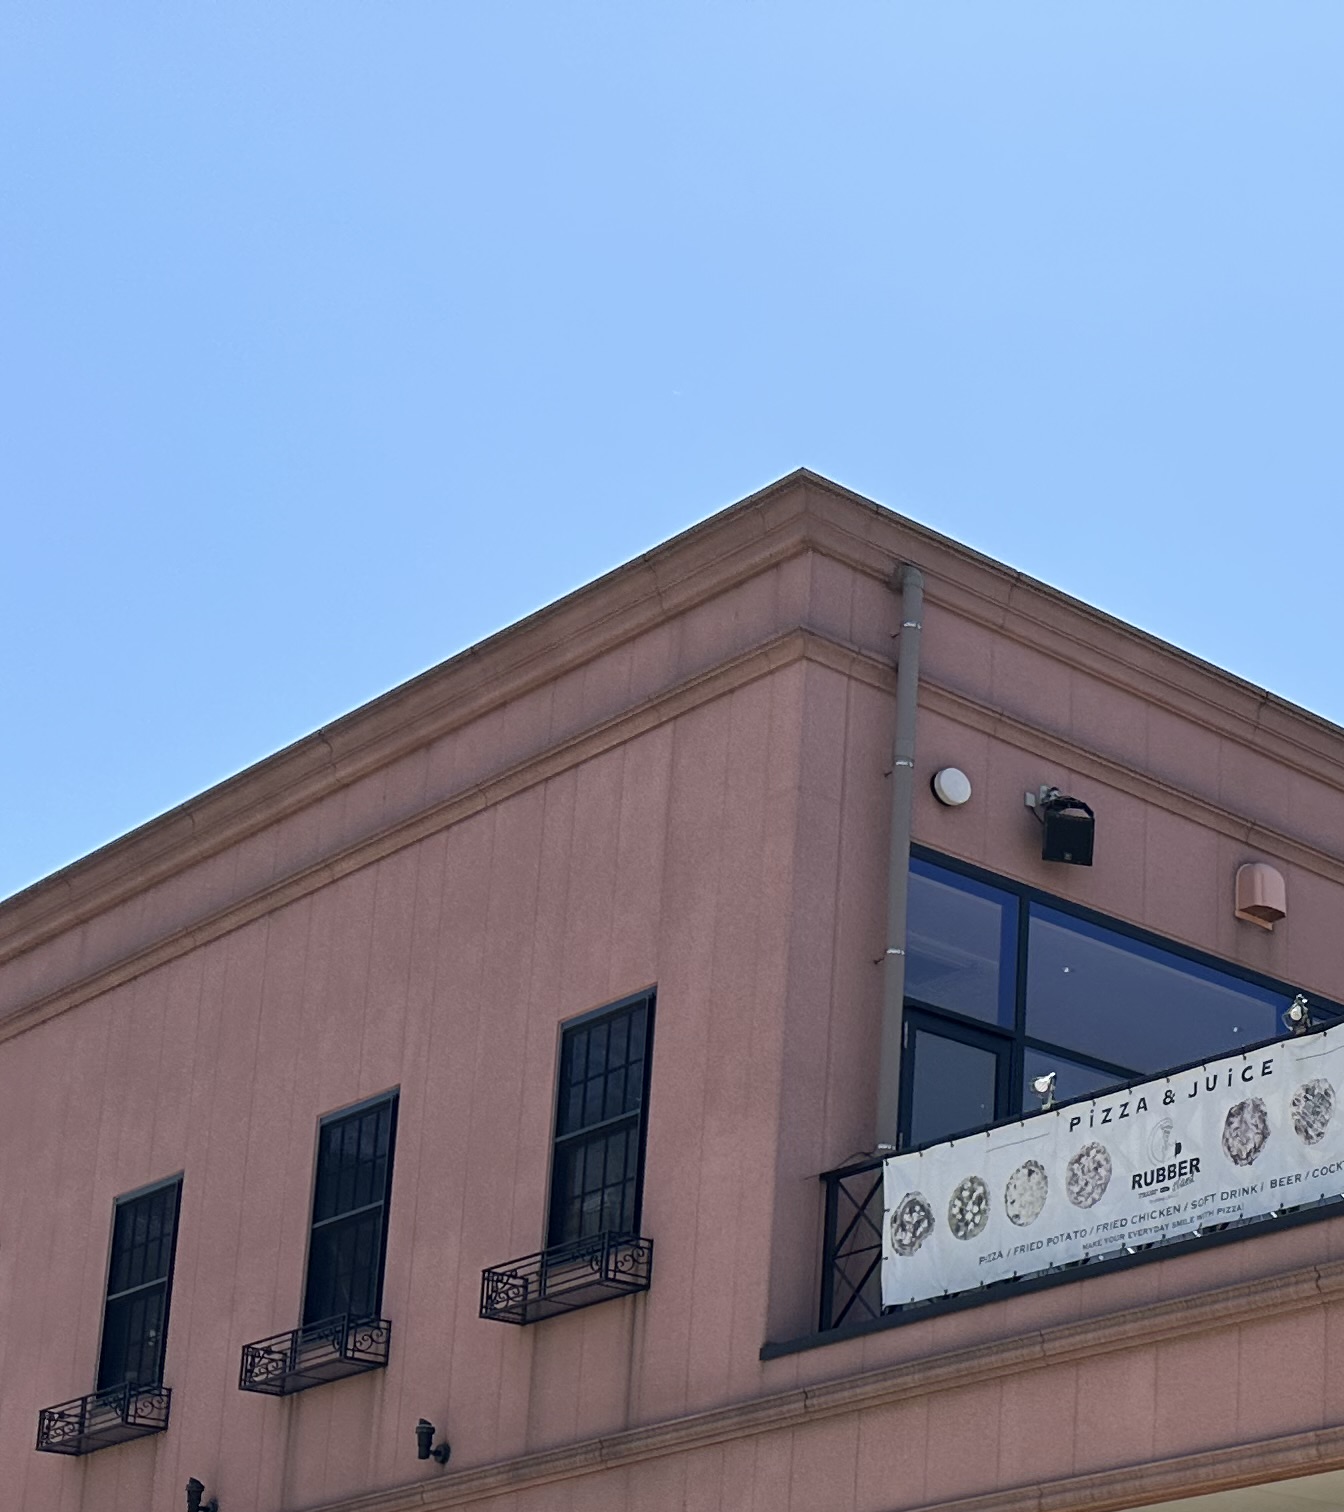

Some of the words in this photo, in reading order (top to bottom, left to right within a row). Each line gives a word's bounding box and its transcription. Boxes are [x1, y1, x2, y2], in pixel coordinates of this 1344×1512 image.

[1162, 1089, 1175, 1106] &
[1131, 1157, 1200, 1190] RUBBER
[979, 1250, 1003, 1265] PIZZA
[1013, 1240, 1043, 1256] FRIED
[1046, 1229, 1087, 1246] POTATO
[1096, 1218, 1128, 1234] FRIED
[1130, 1204, 1181, 1225] CHICKEN
[1191, 1193, 1217, 1210] SOFT
[1220, 1184, 1258, 1201] DRINK
[1270, 1173, 1302, 1189] BEER
[1104, 1234, 1125, 1246] YOUR
[1128, 1224, 1169, 1240] EVERYDAY
[1172, 1216, 1195, 1229] SMILE
